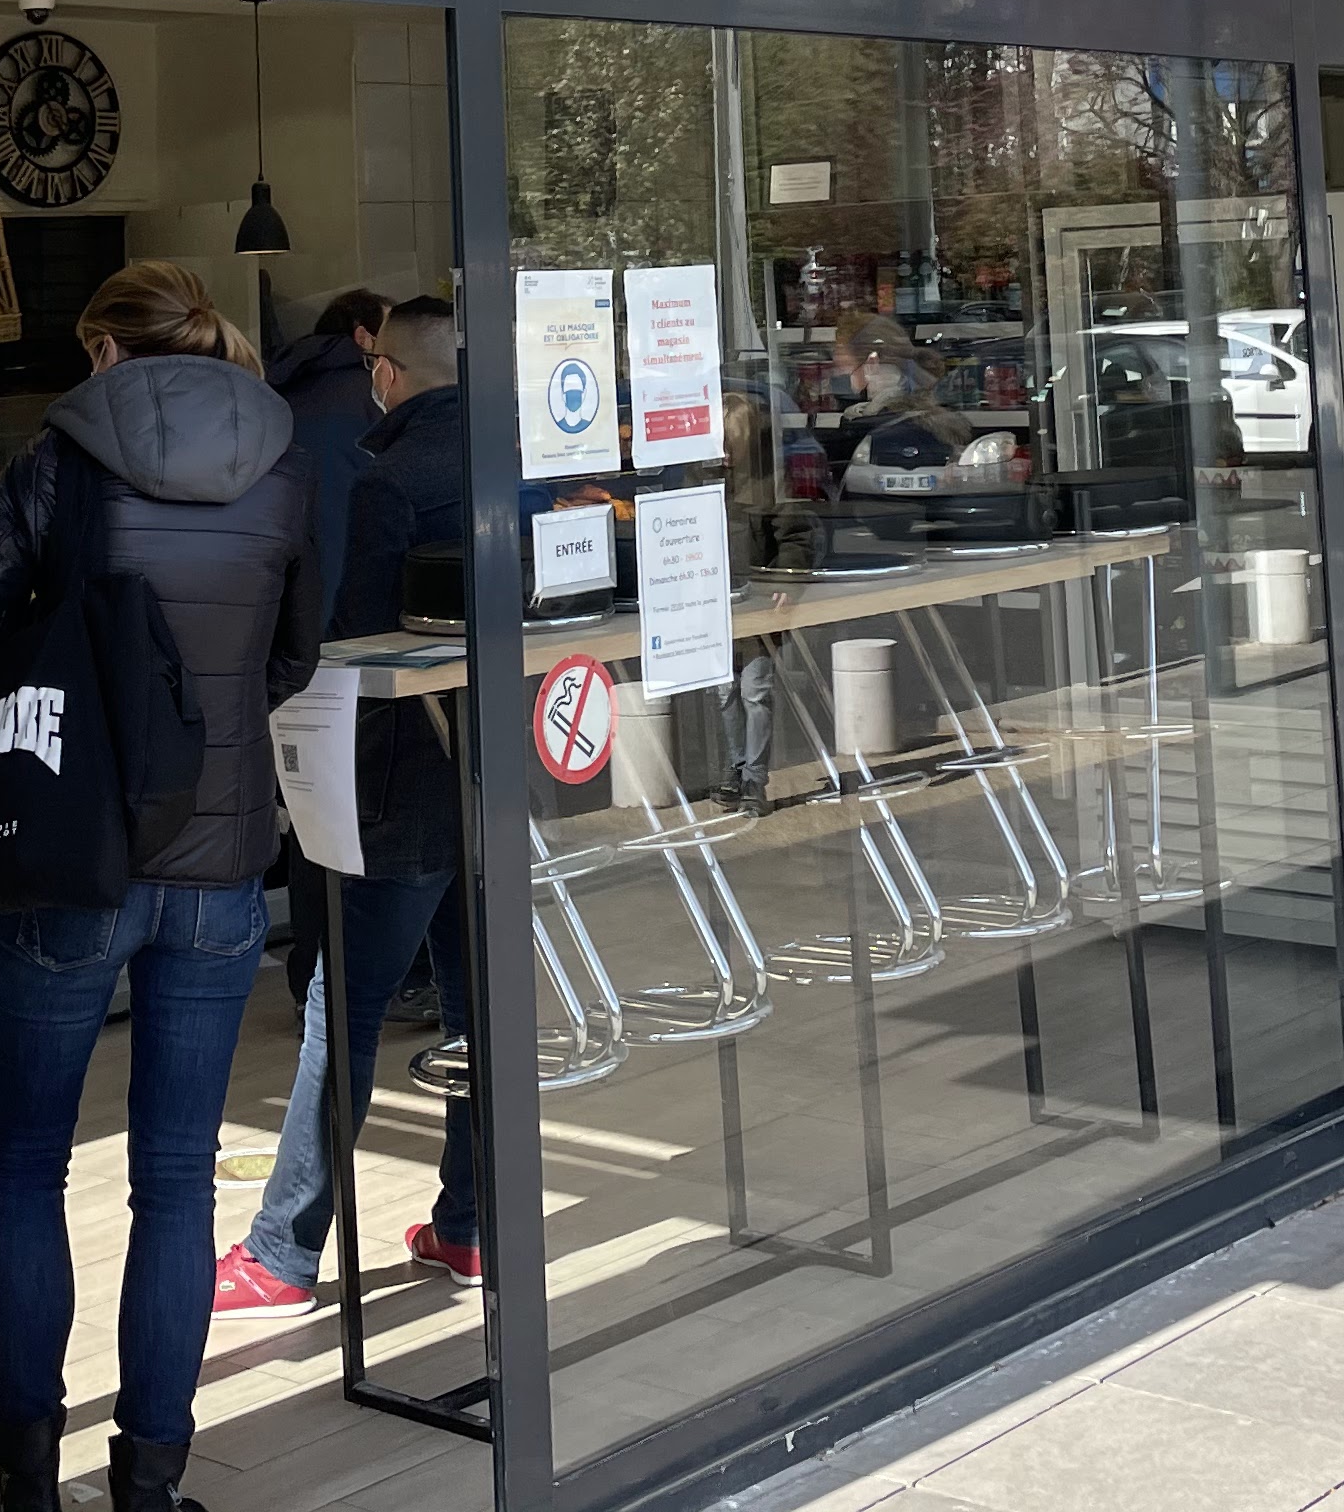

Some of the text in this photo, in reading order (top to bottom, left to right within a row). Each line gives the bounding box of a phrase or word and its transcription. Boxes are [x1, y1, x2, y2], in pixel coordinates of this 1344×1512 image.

[651, 298, 691, 310] Maximum
[567, 322, 595, 332] MASQUE
[657, 317, 684, 329] clients
[556, 332, 599, 342] OBLIGATOIRE
[657, 334, 690, 347] magasin
[665, 515, 698, 529] Horaires
[555, 537, 594, 558] ENTRÉE
[649, 574, 678, 587] Dimanche
